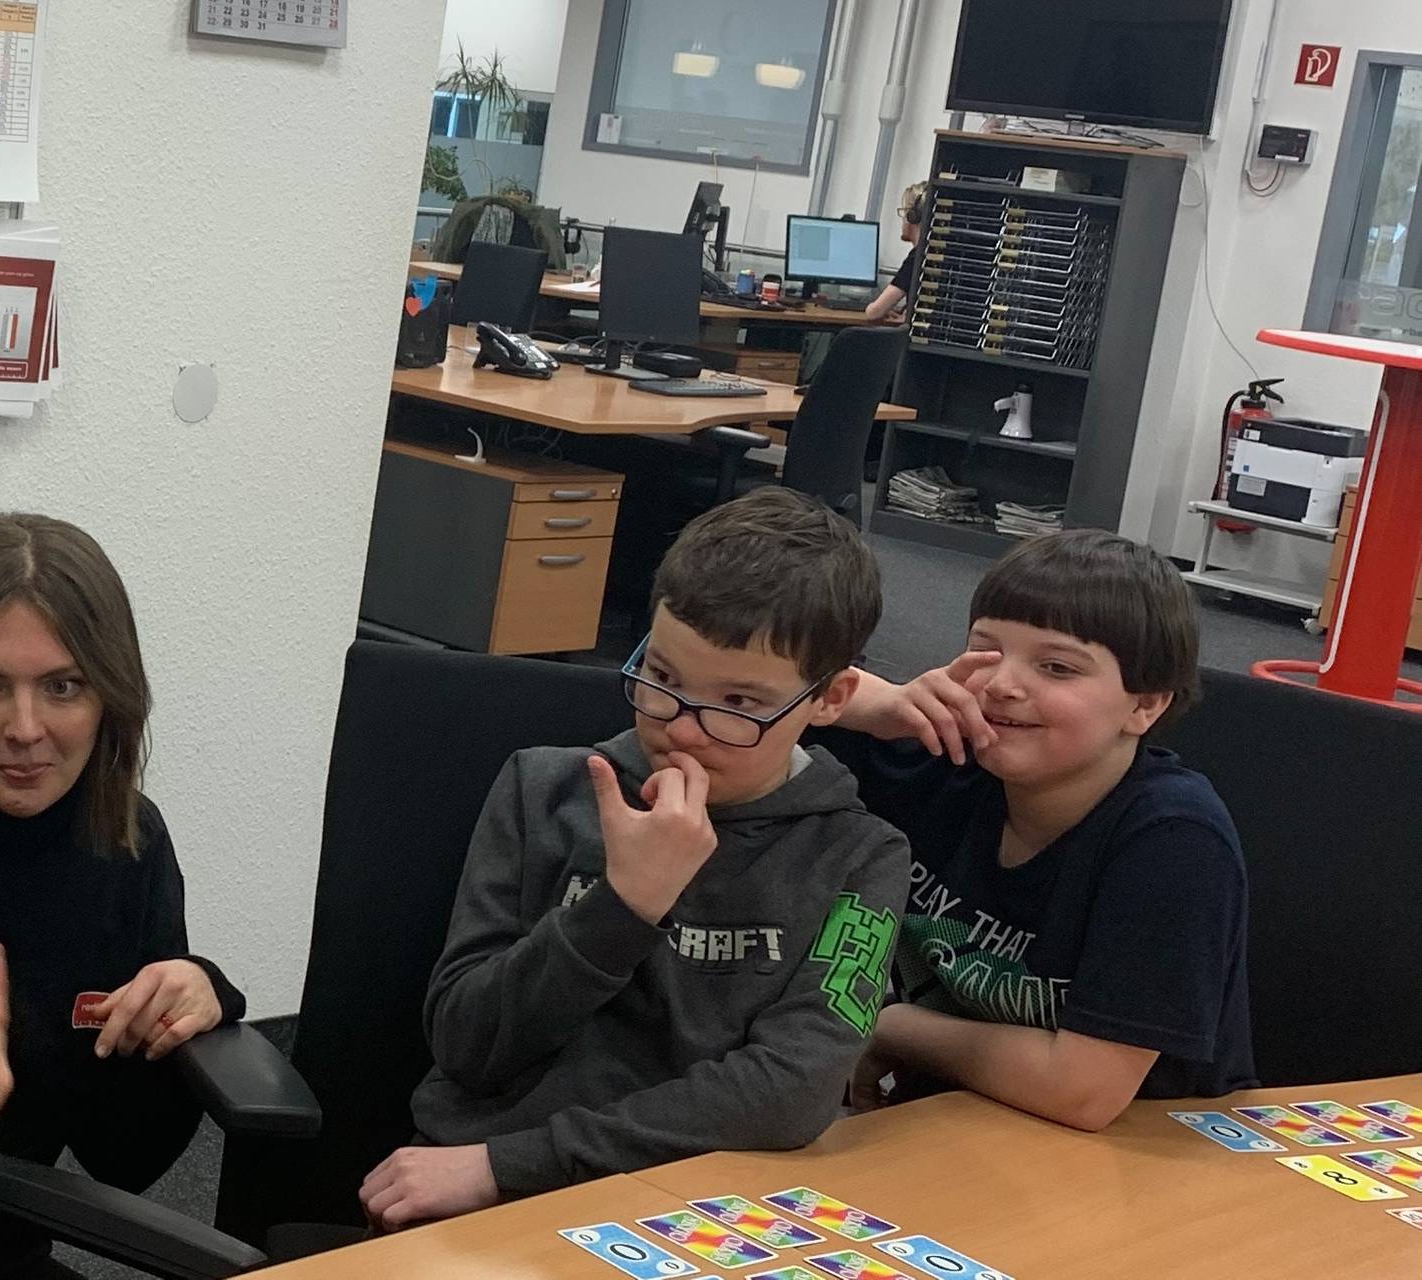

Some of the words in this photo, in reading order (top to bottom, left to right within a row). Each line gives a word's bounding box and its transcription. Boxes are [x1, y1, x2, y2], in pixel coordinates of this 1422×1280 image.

[910, 861, 961, 922] PLAY
[966, 909, 1036, 963] THAT
[1210, 1125, 1242, 1138] 0
[1322, 1170, 1358, 1186] 8
[609, 1243, 647, 1261] 0
[925, 1255, 964, 1272] 0
